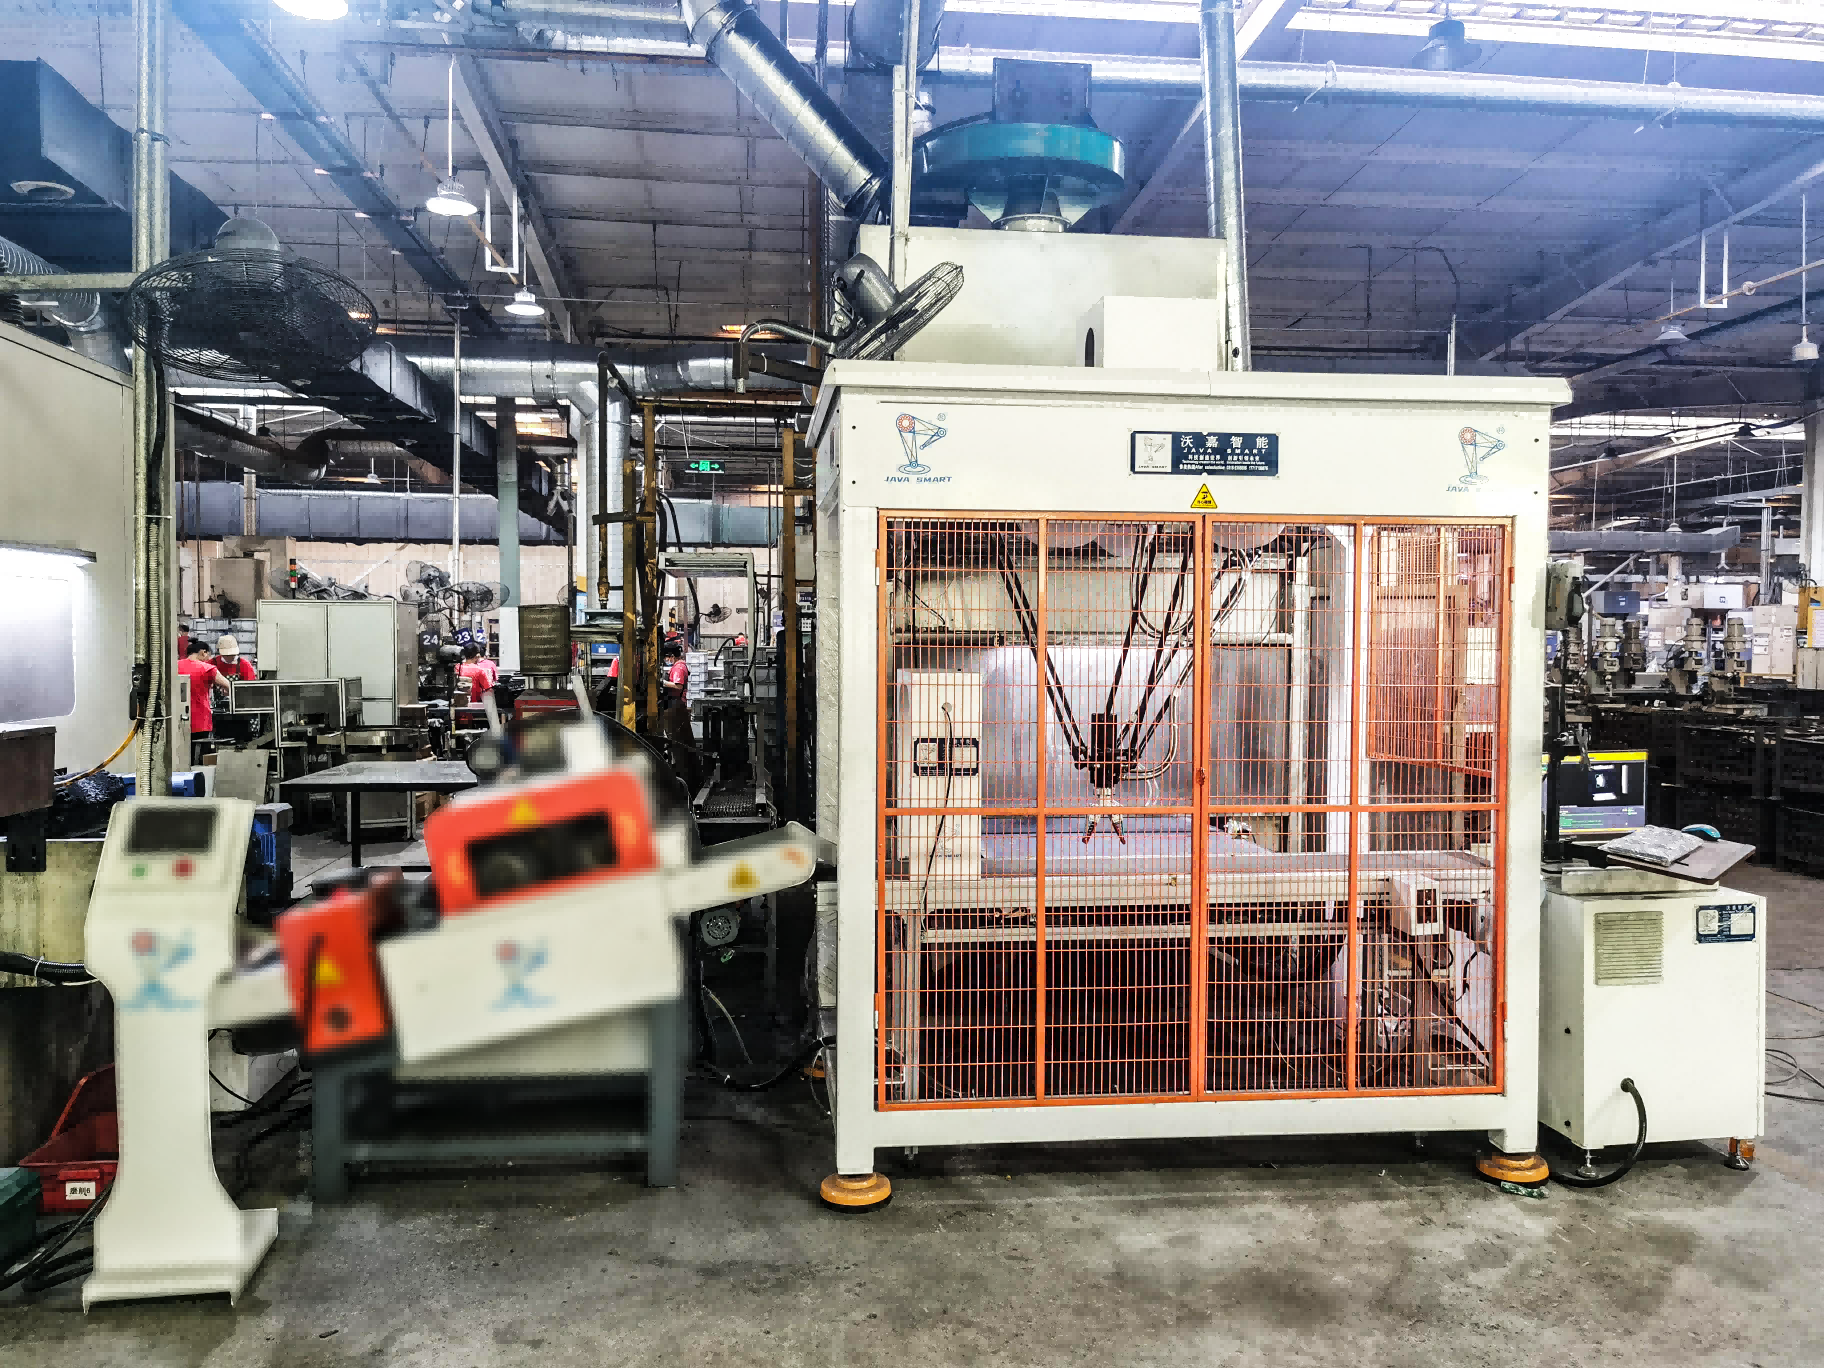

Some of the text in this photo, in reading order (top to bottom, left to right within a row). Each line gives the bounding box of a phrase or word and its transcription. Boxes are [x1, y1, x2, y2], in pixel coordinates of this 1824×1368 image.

[1180, 435, 1269, 449] 沃嘉智能
[423, 635, 438, 645] 24
[455, 631, 470, 644] 23
